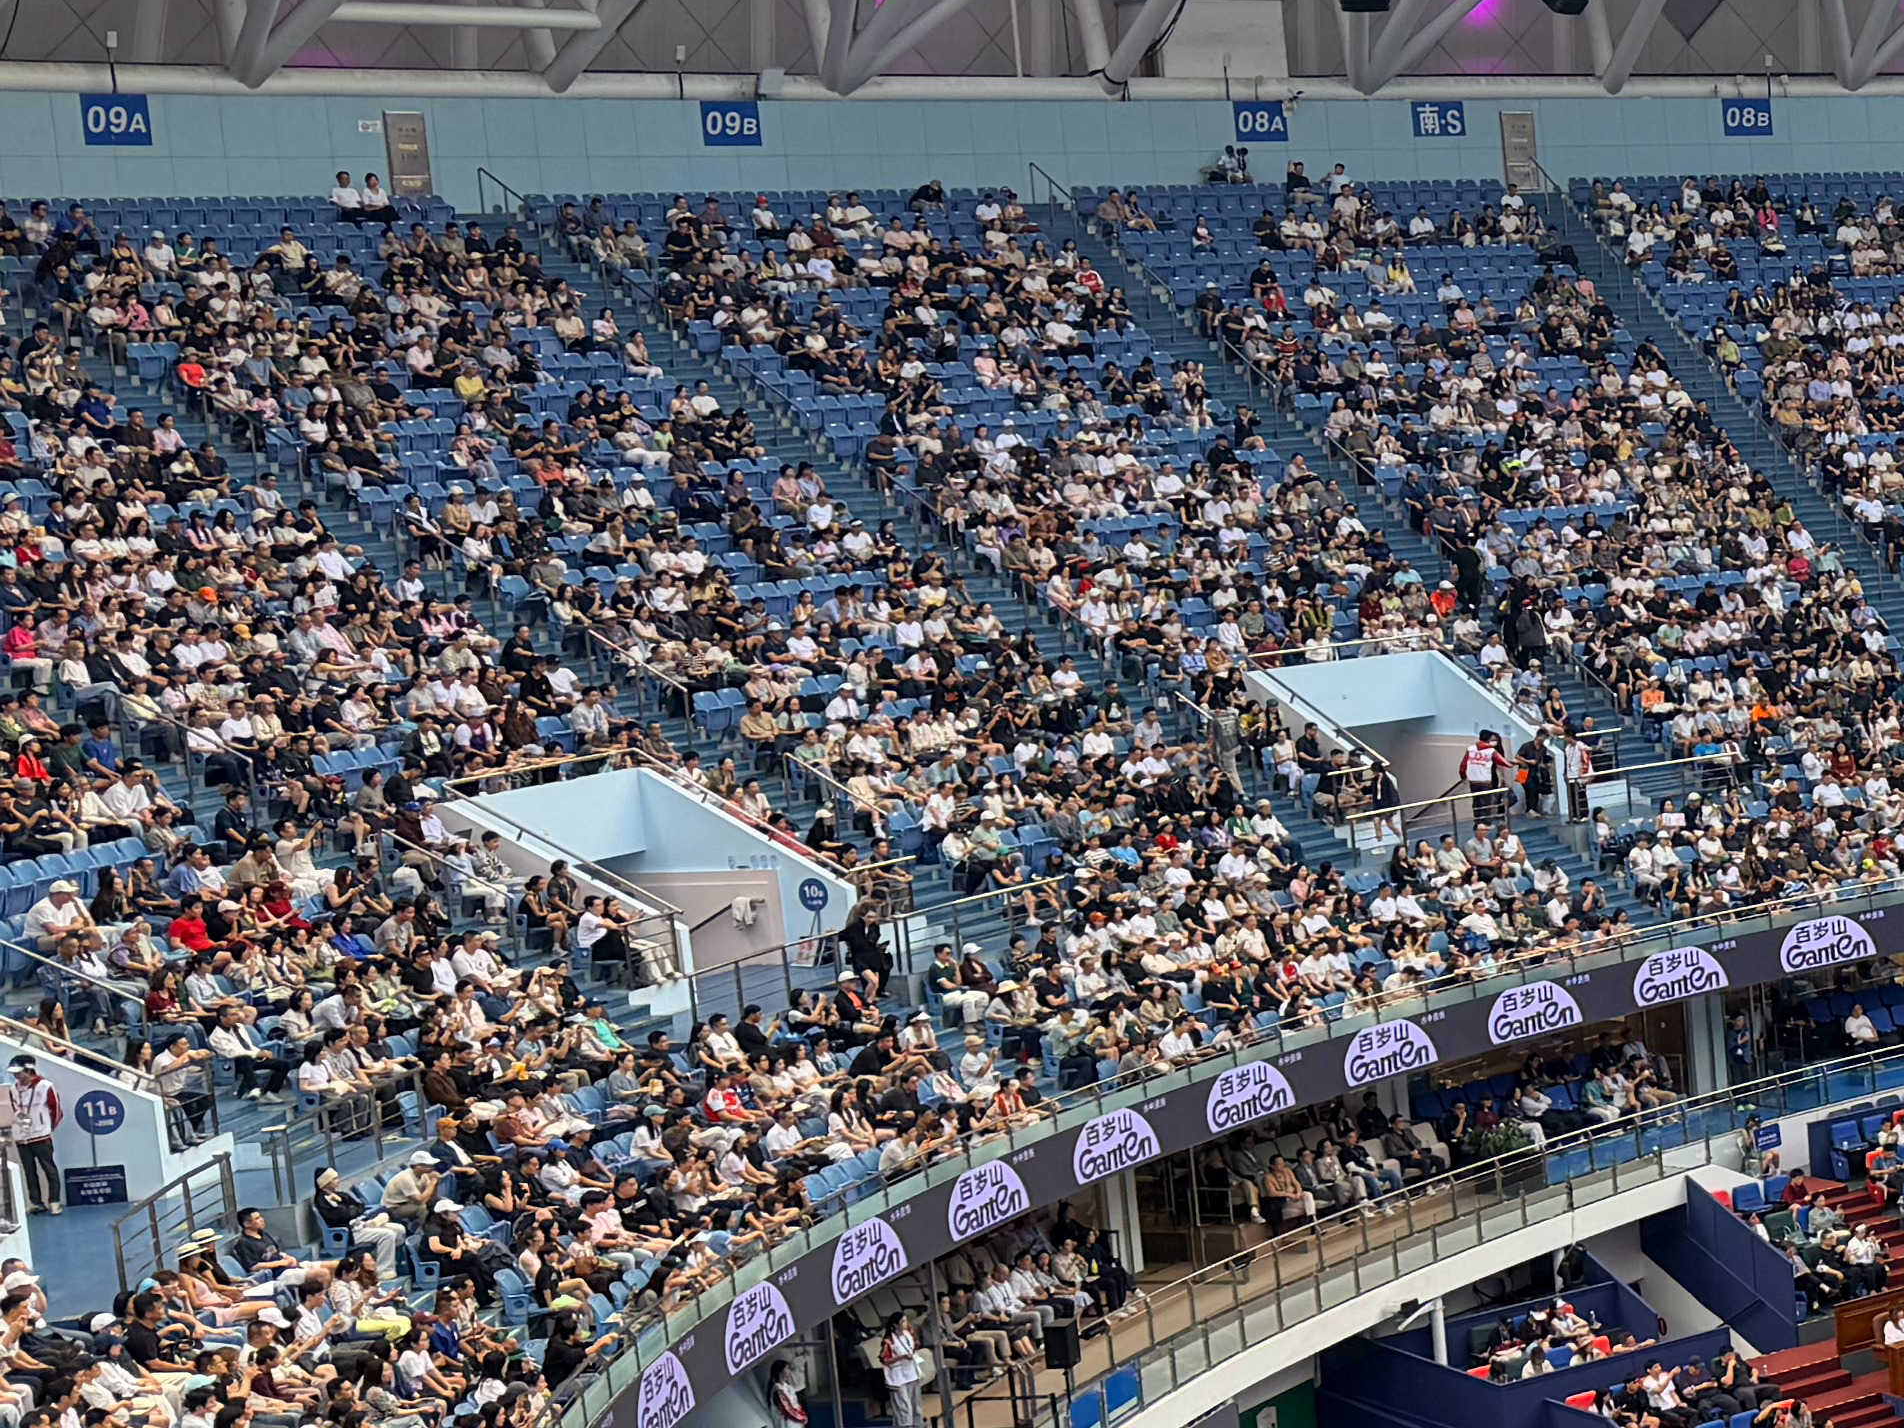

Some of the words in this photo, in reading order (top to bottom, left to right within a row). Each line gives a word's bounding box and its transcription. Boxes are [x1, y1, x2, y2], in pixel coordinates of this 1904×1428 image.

[87, 106, 147, 133] 09A
[706, 111, 757, 135] 09B
[1238, 111, 1284, 132] 08A
[1727, 107, 1770, 127] 08B
[1796, 920, 1847, 943] 百岁山
[1649, 950, 1699, 976] 百岁山
[1503, 985, 1553, 1012] 百岁山
[1359, 1024, 1409, 1053] 百岁山
[1220, 1066, 1267, 1097] 百岁山
[1086, 1113, 1132, 1147] 百岁山
[959, 1165, 1003, 1201] 百岁山
[842, 1222, 881, 1262] 百岁山
